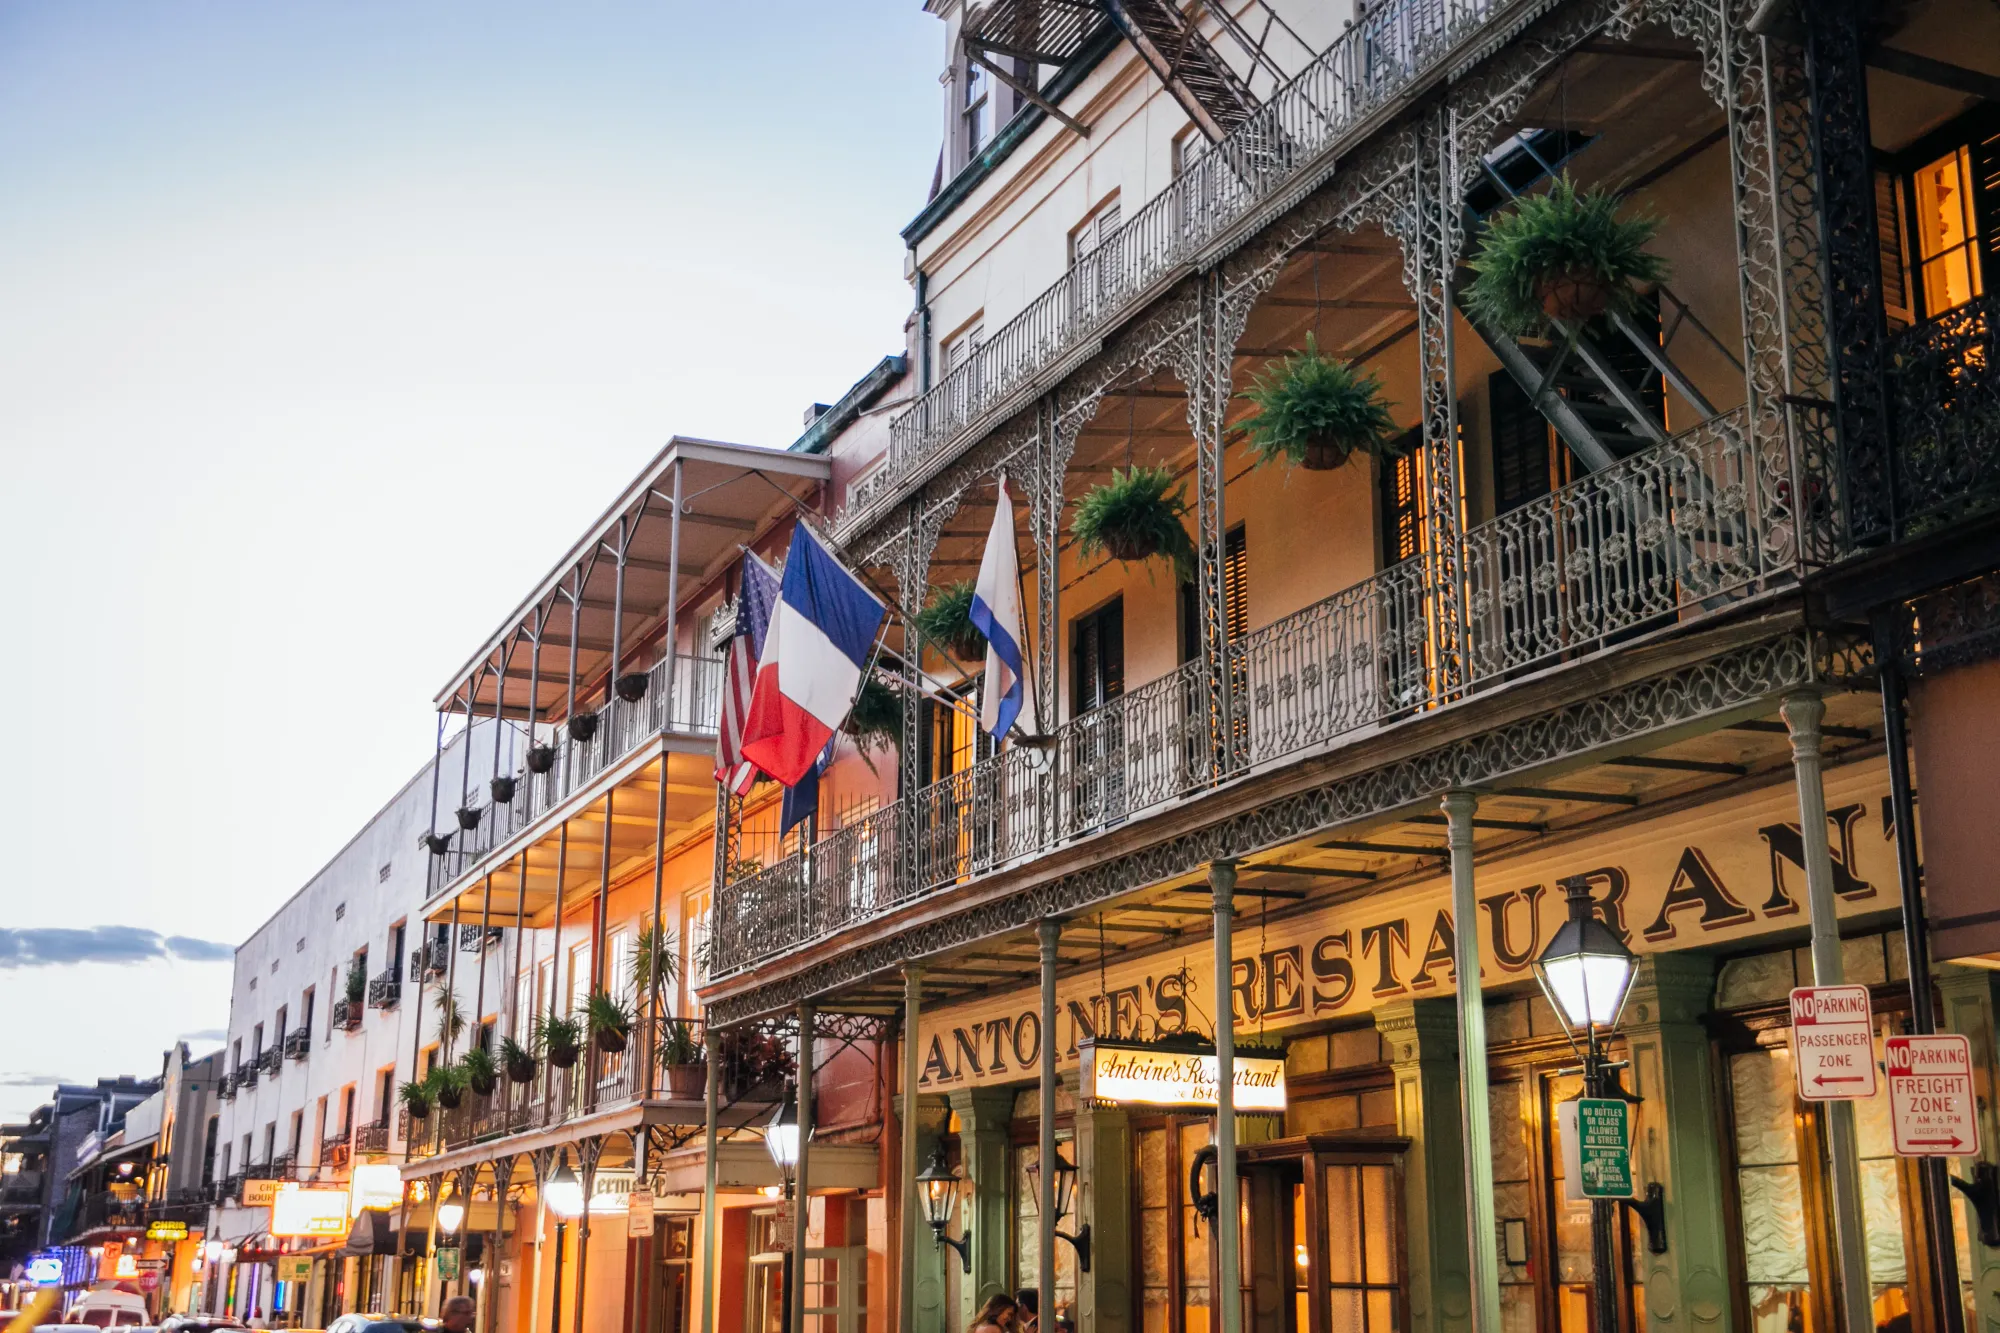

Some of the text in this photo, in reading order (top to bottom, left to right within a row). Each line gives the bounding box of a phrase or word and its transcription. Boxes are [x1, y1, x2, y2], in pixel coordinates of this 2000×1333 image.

[919, 789, 1917, 1087] ANTONE'S RESTAURAN
[1793, 996, 1865, 1018] NO PARKING
[1800, 1033, 1868, 1048] PASSENGER
[1819, 1054, 1853, 1067] ZONE
[1886, 1046, 1965, 1069] NO PARKING
[1099, 1052, 1281, 1088] Antoine's Resurant
[1896, 1078, 1963, 1094] FREIGHT
[1910, 1097, 1954, 1112] ZONE
[1583, 1107, 1622, 1117] NO BOTTLES
[1587, 1117, 1619, 1126] OR GLASS
[1904, 1115, 1910, 1124] 7
[1947, 1115, 1962, 1124] PM
[1589, 1127, 1618, 1135] ALLOWED
[1914, 1127, 1938, 1135] EXCEPT
[1597, 1135, 1622, 1144] STREET
[150, 1221, 186, 1230] CHRIS
